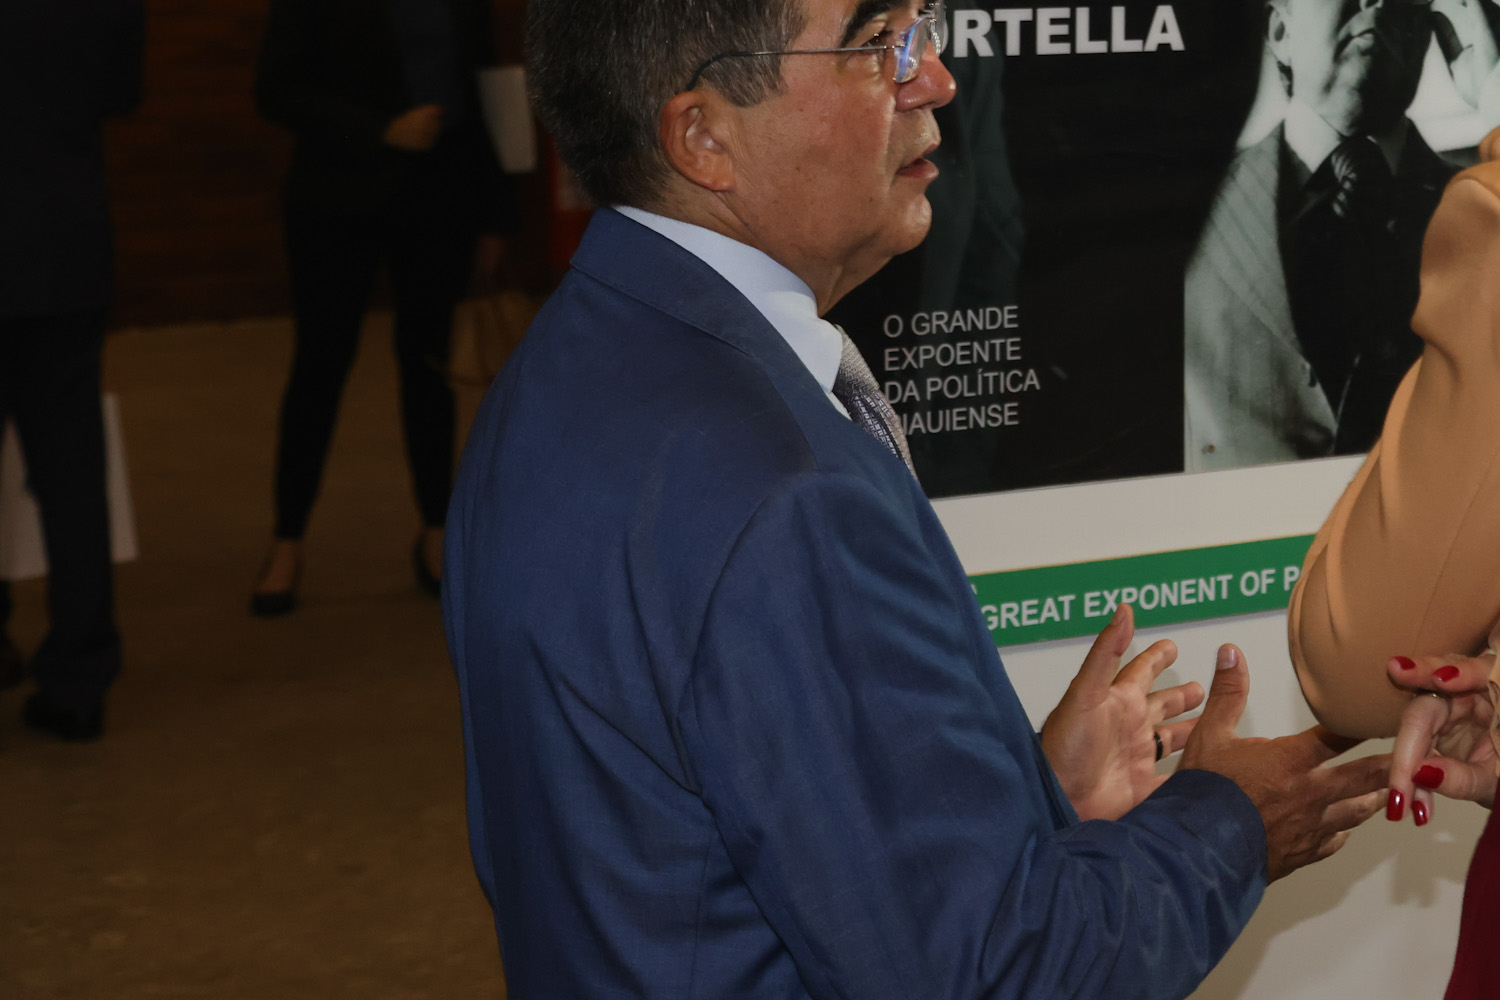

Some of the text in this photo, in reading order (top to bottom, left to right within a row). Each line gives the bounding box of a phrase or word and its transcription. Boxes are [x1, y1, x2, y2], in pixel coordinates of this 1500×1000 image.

[943, 4, 1186, 58] RTELLA
[883, 305, 1020, 338] O GRANDE
[884, 337, 1022, 371] EXPOENTE
[885, 368, 1041, 404] DA POLÍTICA
[903, 402, 1020, 436] IAUIENSE
[981, 594, 1076, 631] GREAT
[1084, 574, 1233, 618] EXPONENT
[1240, 568, 1276, 597] OF
